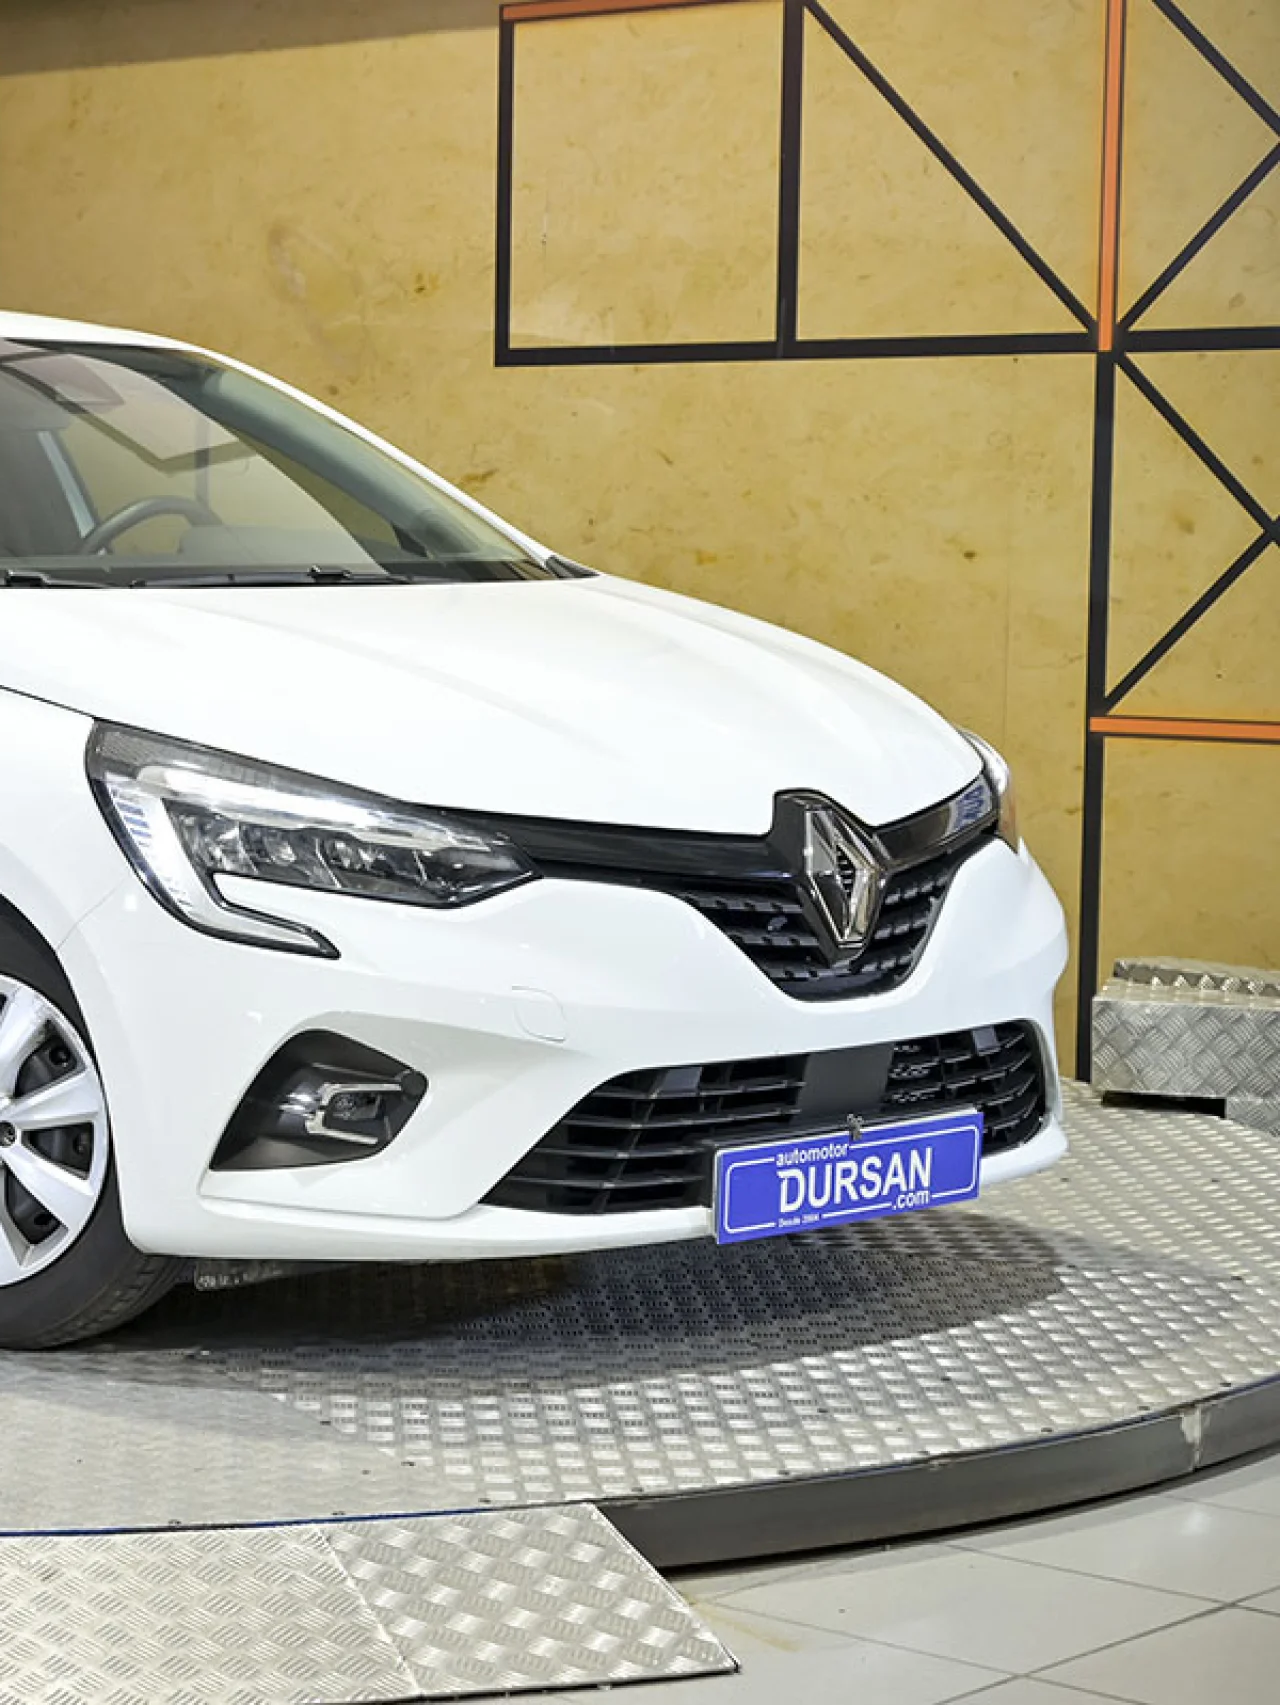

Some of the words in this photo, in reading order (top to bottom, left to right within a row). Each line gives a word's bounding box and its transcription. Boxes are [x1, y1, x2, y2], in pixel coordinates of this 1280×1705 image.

[776, 1143, 848, 1166] automotor
[776, 1147, 932, 1213] DURSAN
[891, 1191, 930, 1210] .com
